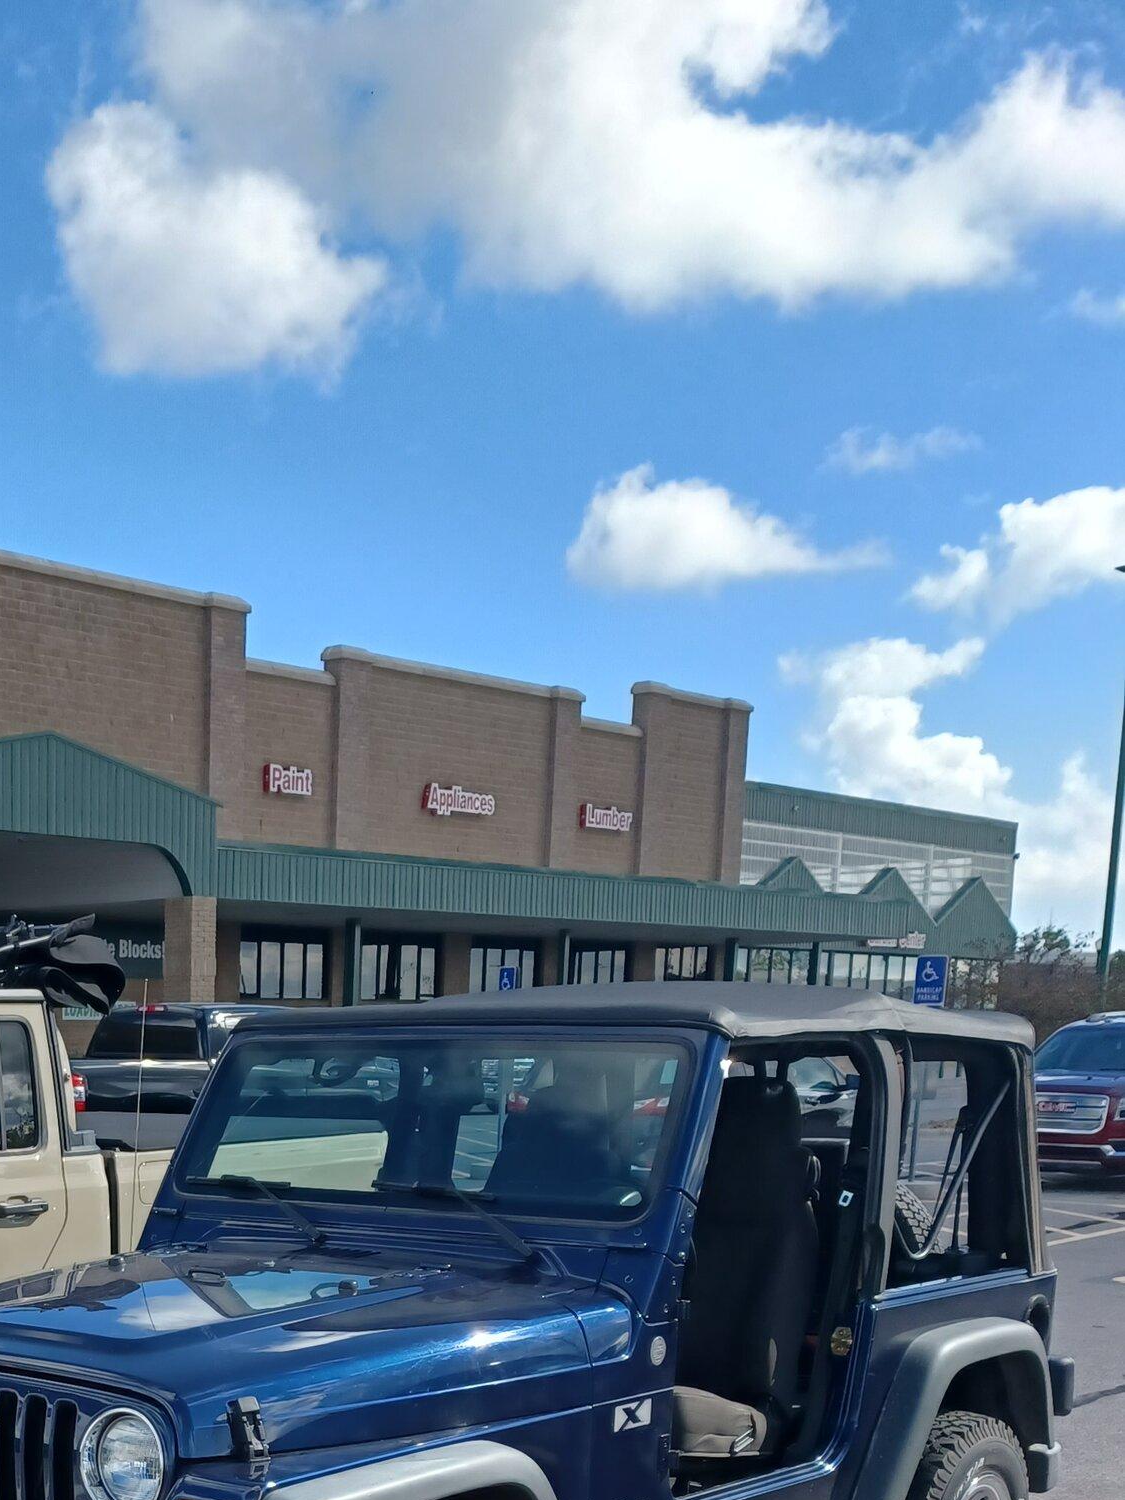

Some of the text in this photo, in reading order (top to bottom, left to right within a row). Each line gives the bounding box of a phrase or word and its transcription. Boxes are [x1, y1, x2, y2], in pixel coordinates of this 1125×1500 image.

[271, 765, 312, 794] Paint
[429, 784, 494, 815] Appliances
[586, 804, 632, 831] Lumber
